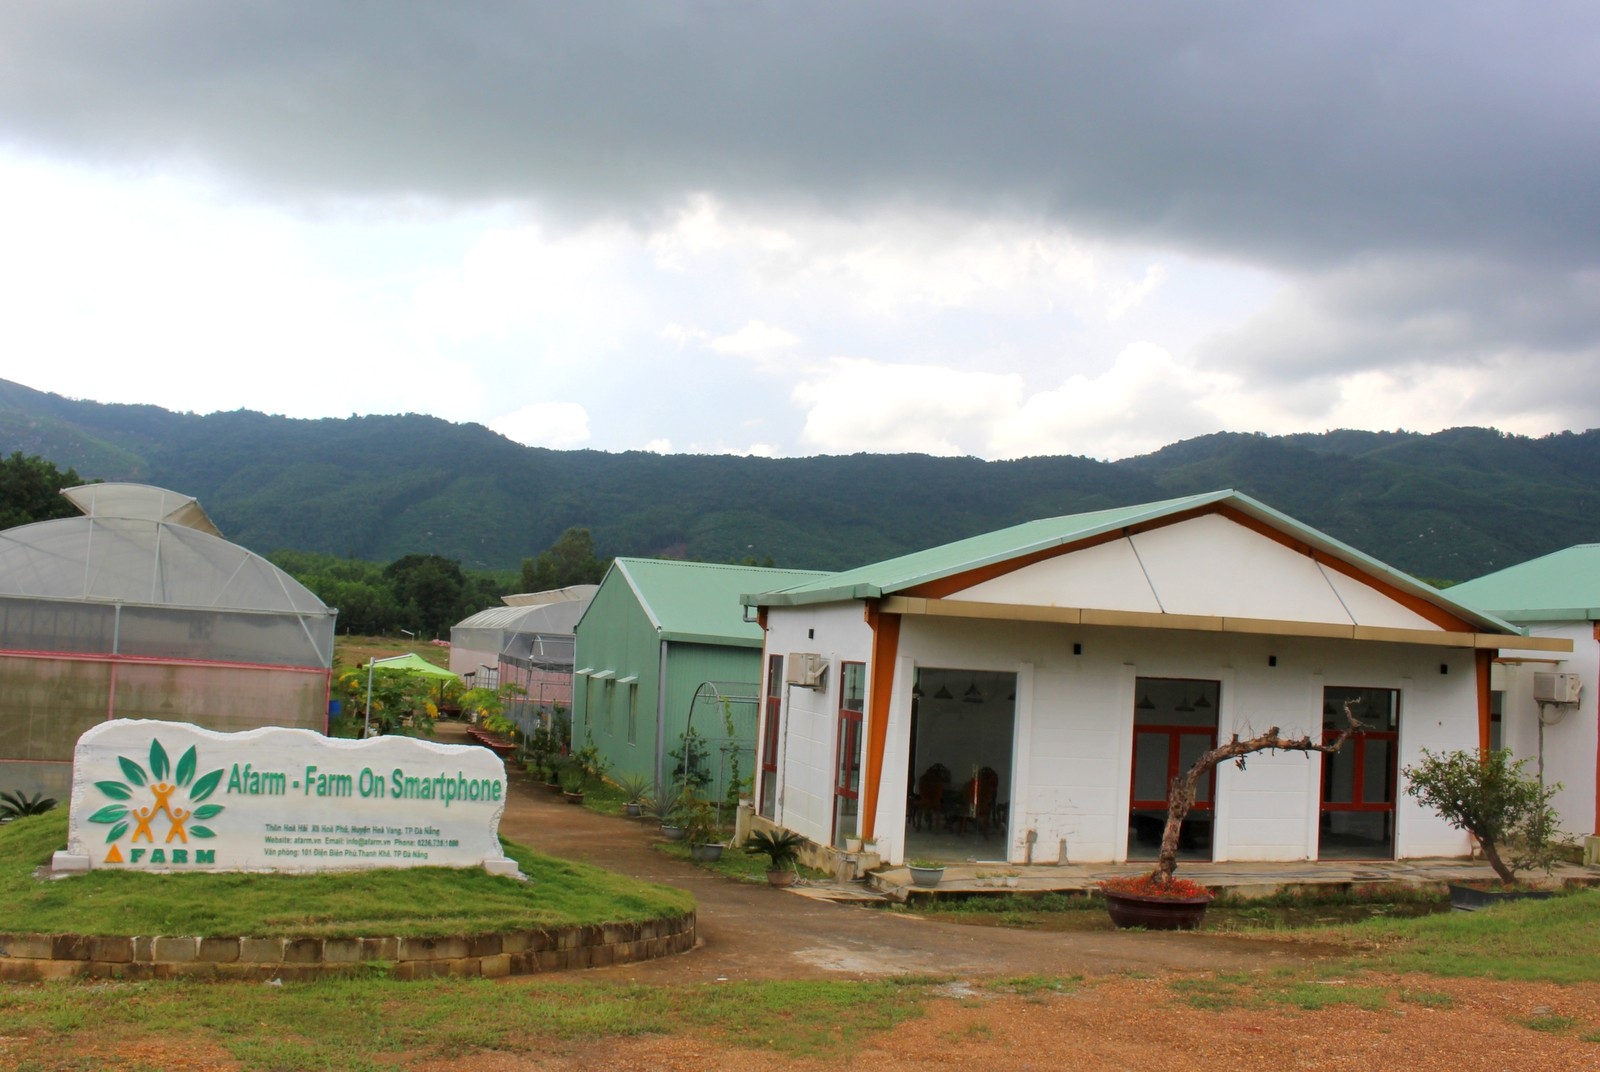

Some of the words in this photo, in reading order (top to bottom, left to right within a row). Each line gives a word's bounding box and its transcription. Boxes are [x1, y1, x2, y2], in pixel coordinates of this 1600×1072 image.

[227, 763, 286, 796] Afarm
[305, 765, 352, 797] Farm
[359, 767, 385, 798] On
[391, 768, 502, 807] Smartphone
[294, 836, 322, 845] afarm.vn
[325, 837, 344, 845] Email:
[346, 837, 391, 848] info@afarm.vn
[394, 838, 416, 846] Phone:
[302, 848, 312, 856] 101
